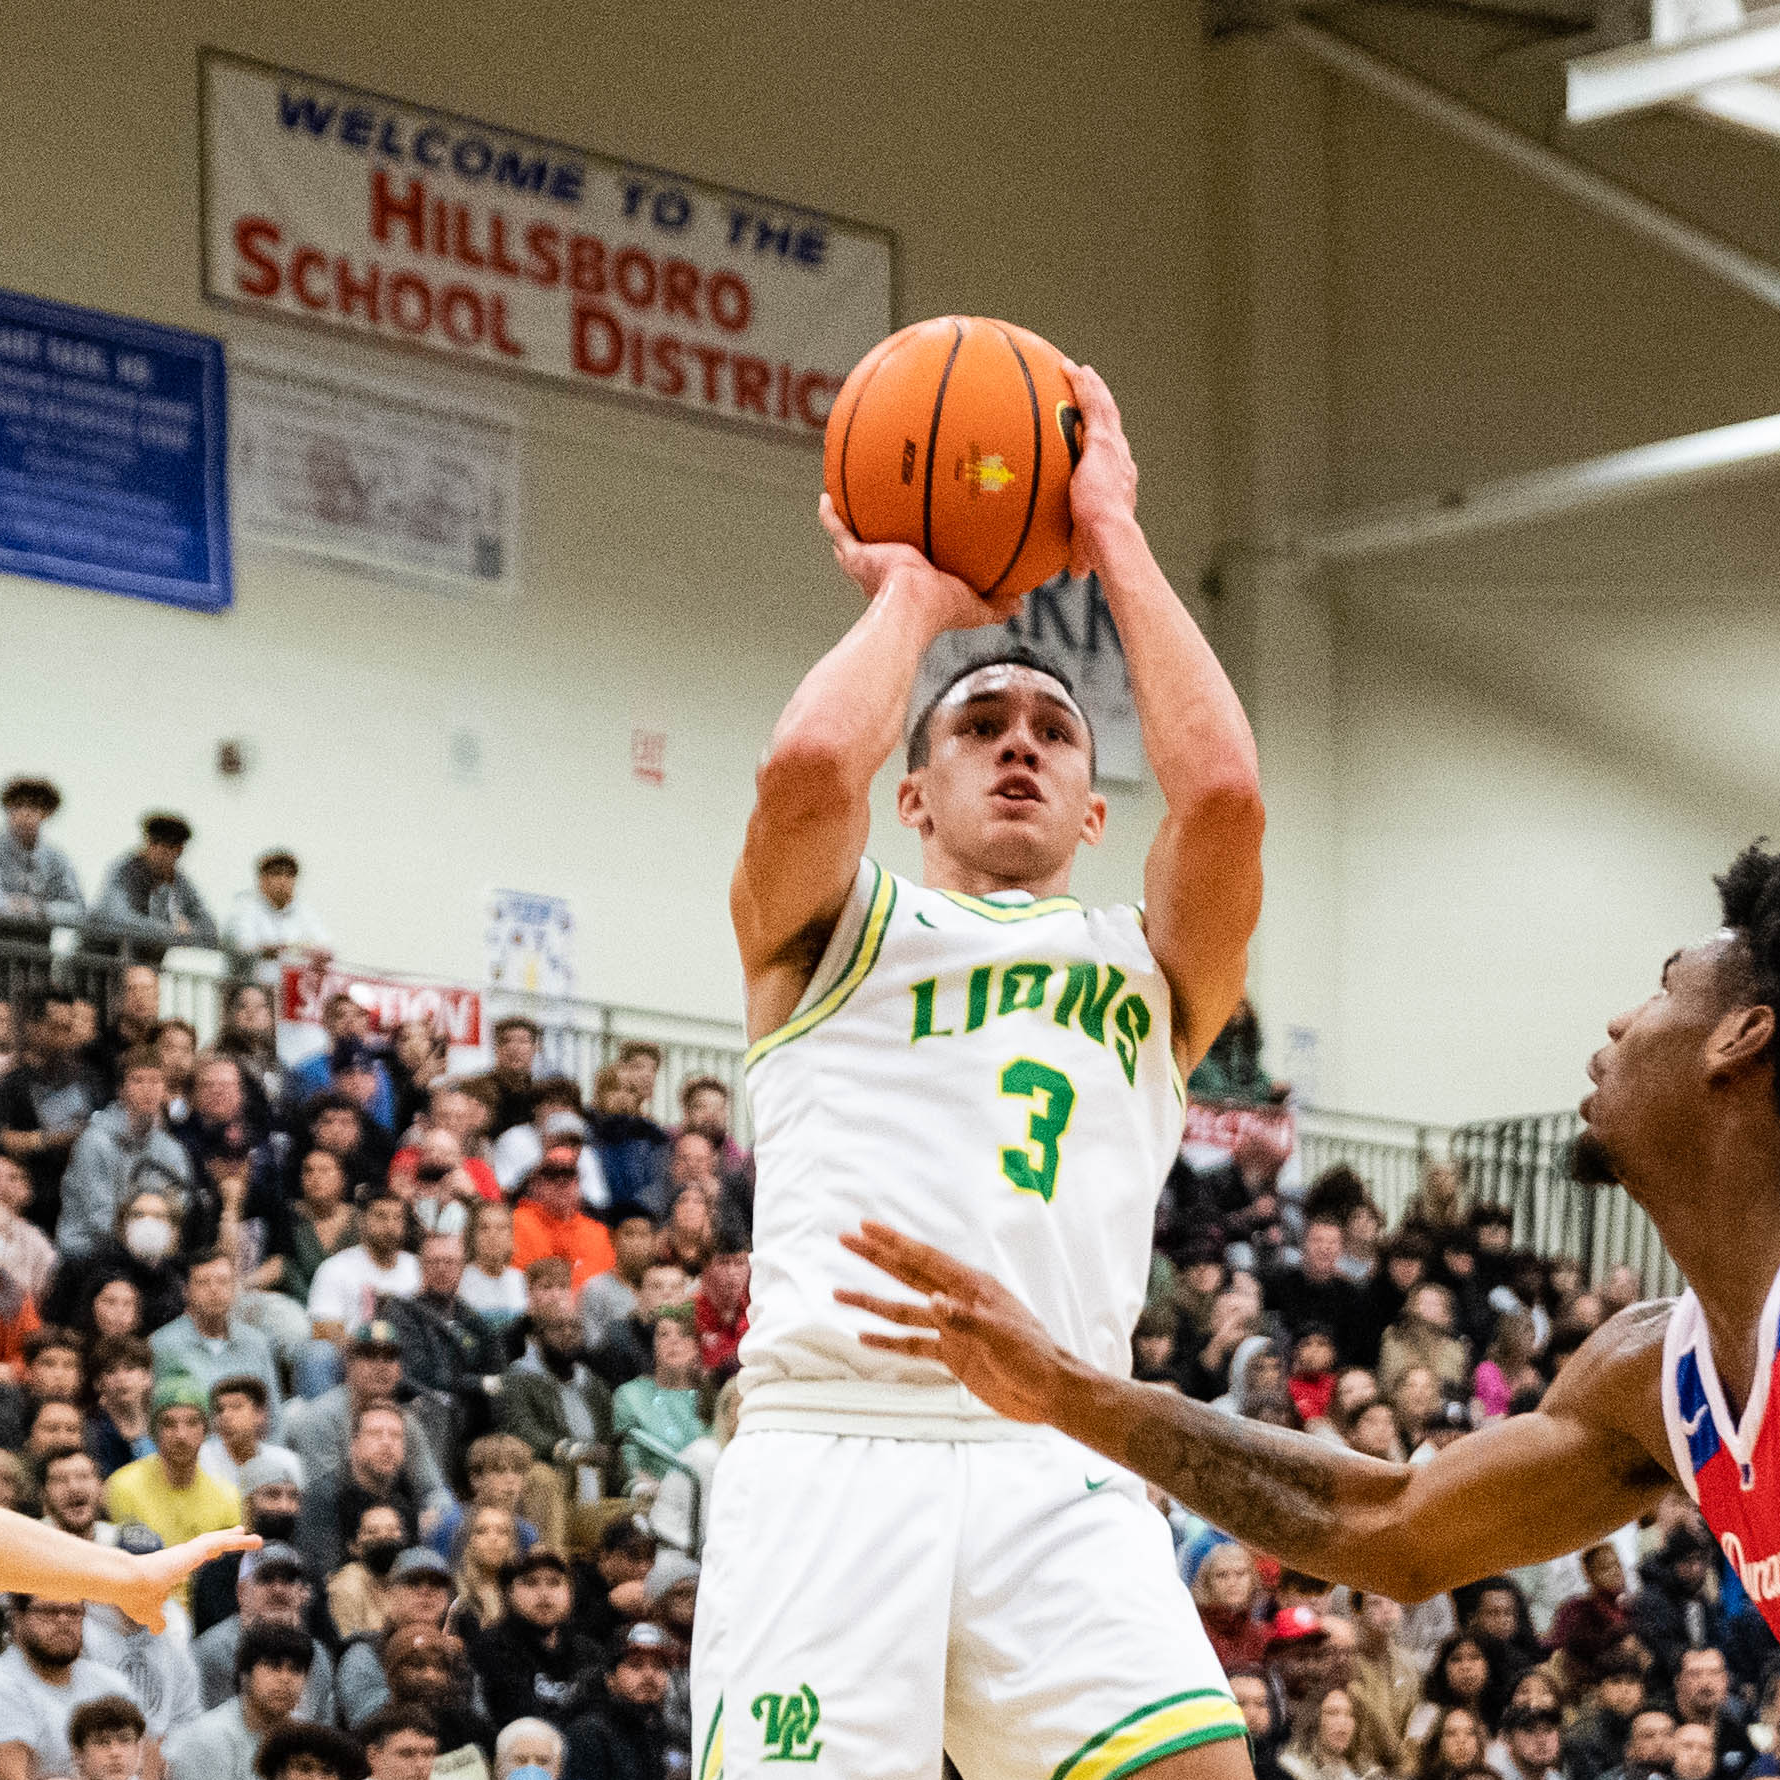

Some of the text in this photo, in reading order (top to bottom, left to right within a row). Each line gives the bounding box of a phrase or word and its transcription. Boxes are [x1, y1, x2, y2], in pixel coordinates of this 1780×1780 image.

[277, 91, 828, 268] WELCOME TO THE
[368, 168, 754, 335] HILLSBORO
[232, 214, 526, 359] SCHOOL
[910, 962, 1151, 1088] LIONS
[997, 1056, 1077, 1204] 3
